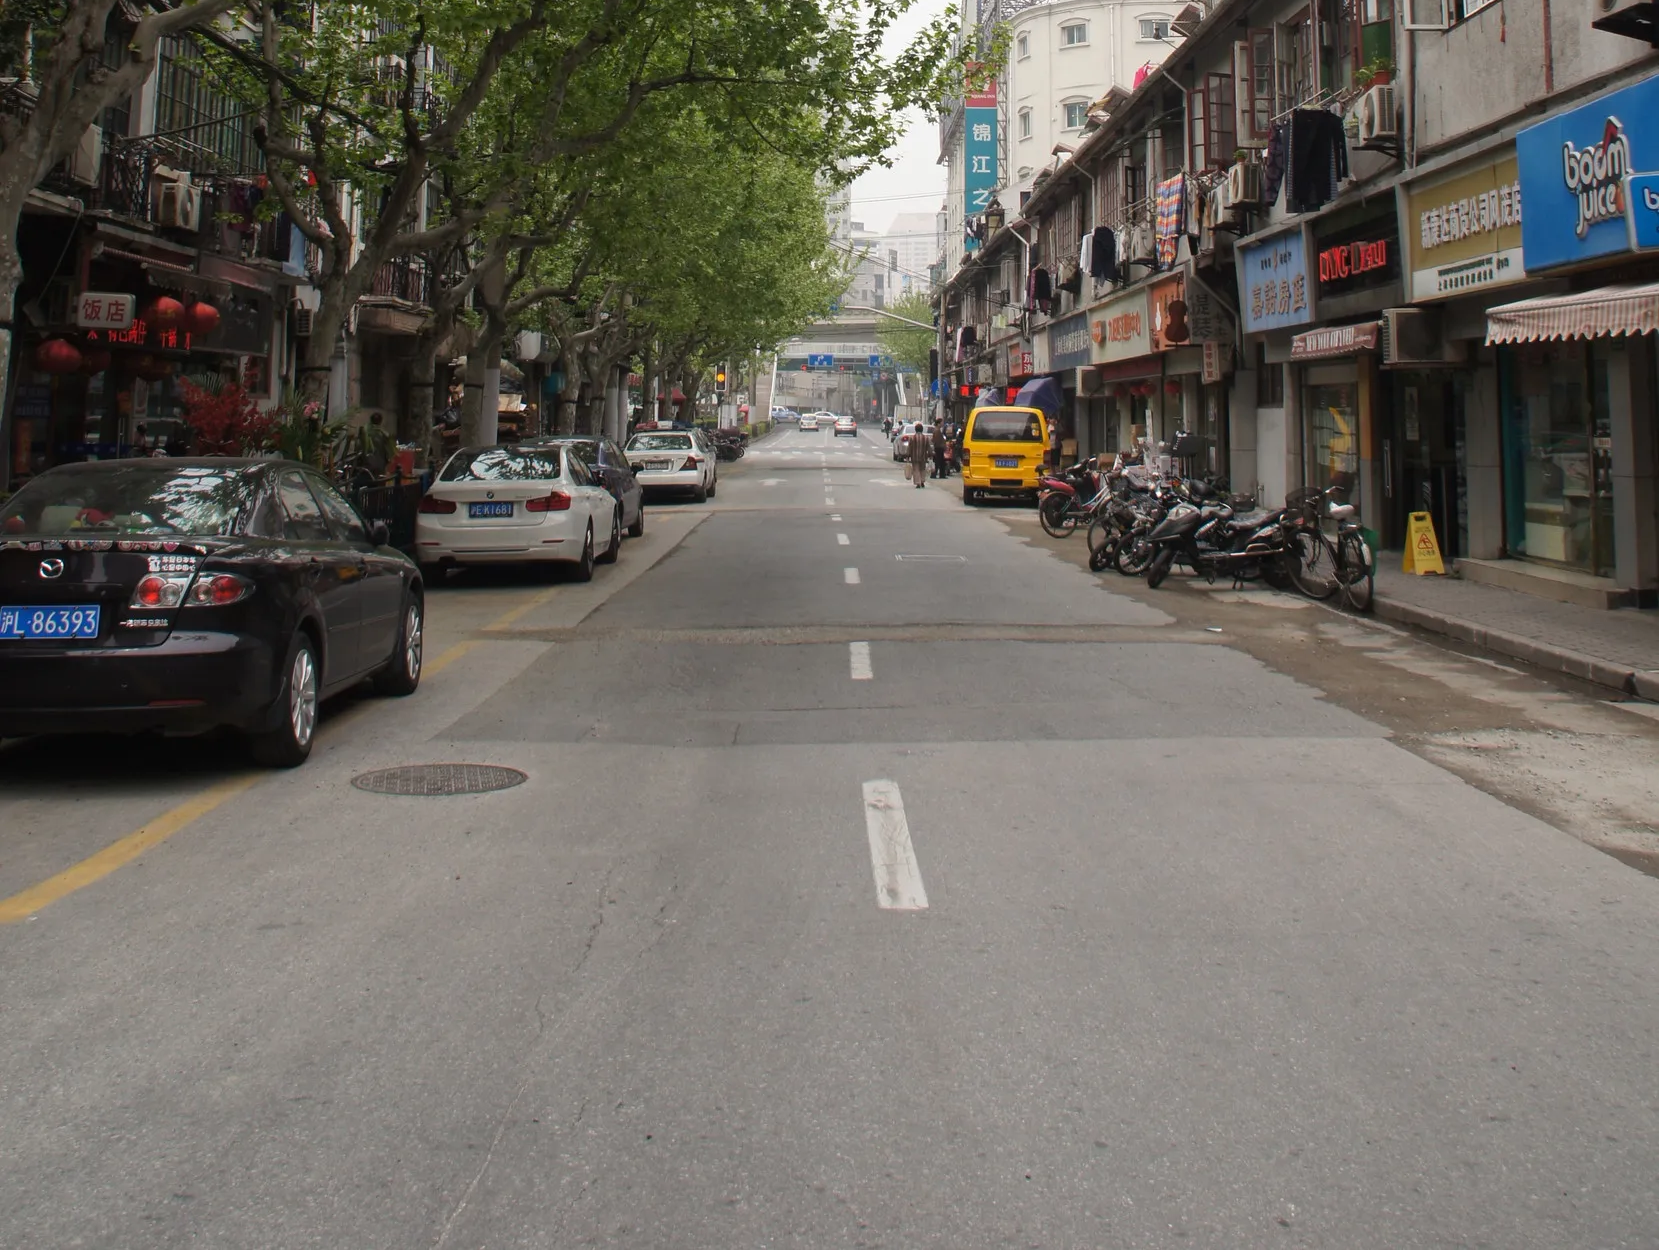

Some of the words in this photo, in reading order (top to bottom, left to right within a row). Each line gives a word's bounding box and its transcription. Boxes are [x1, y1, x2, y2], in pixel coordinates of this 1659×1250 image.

[1562, 128, 1632, 193] boom
[1575, 178, 1619, 237] juice
[1319, 246, 1349, 282] NYC
[82, 298, 126, 323] 饭店
